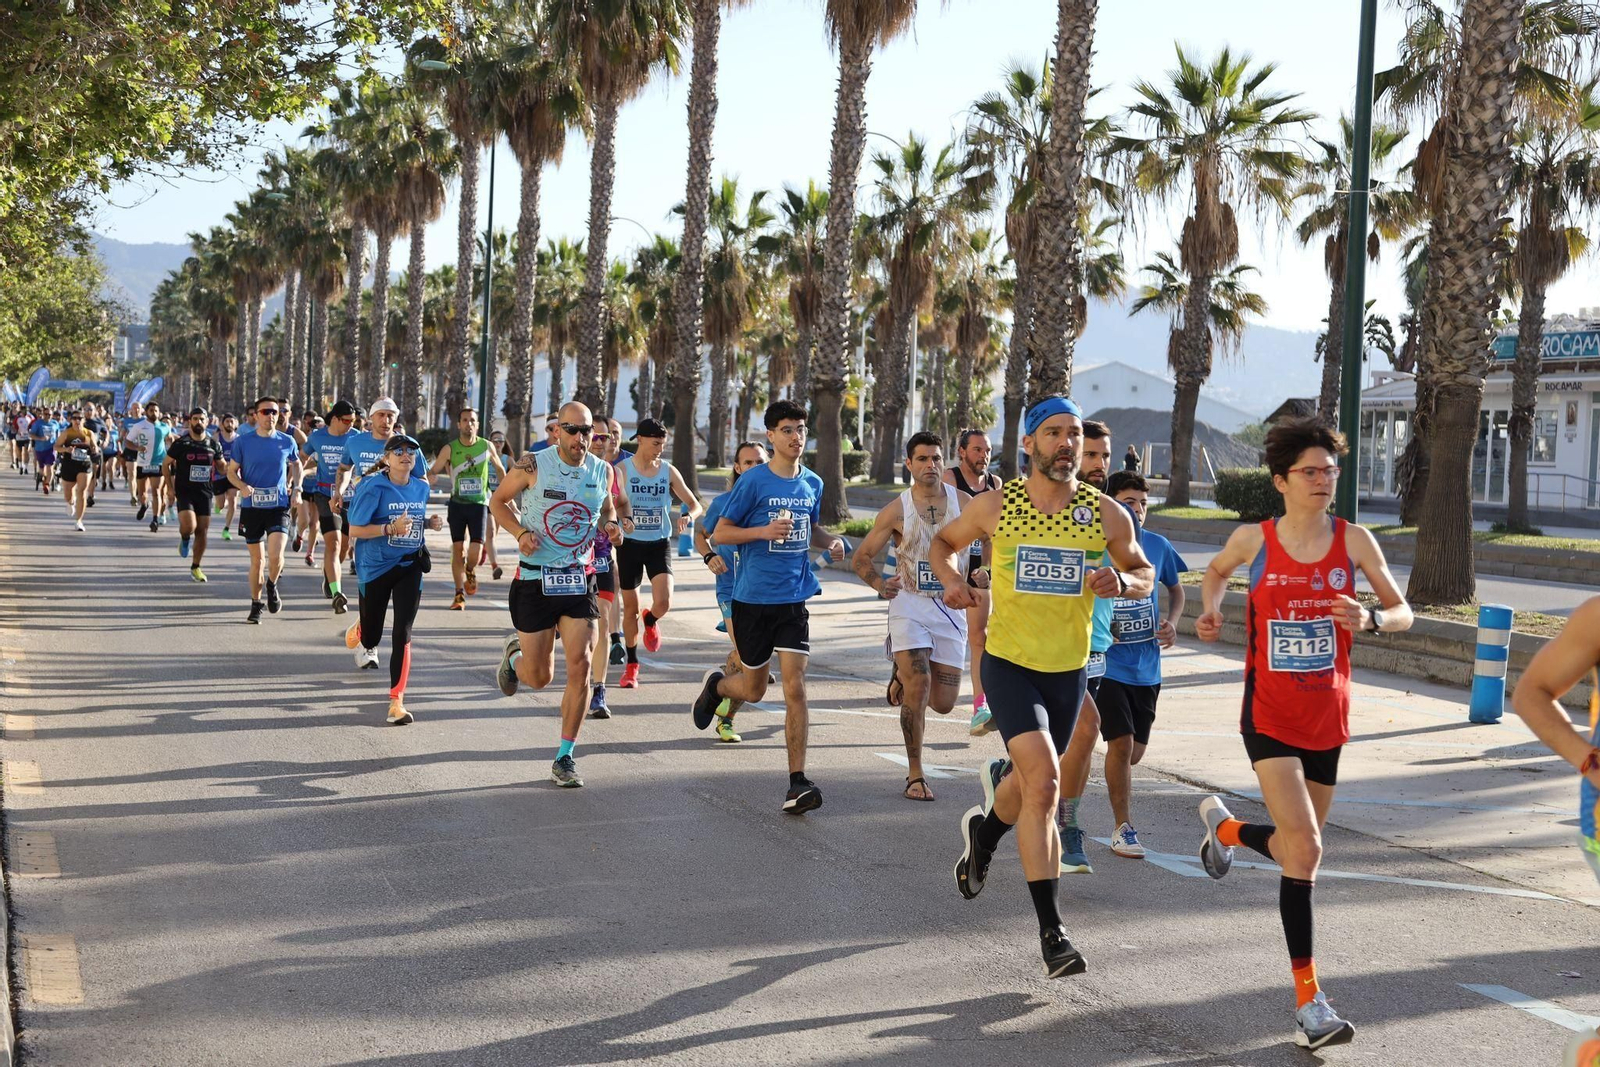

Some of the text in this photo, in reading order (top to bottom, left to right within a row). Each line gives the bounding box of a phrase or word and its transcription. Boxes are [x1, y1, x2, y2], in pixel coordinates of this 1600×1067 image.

[1545, 381, 1582, 391] ROCAMAR
[631, 483, 666, 496] nerja
[388, 501, 424, 510] mayoral
[636, 516, 660, 524] 1696
[1024, 563, 1076, 580] 2053
[548, 574, 581, 585] 1669
[1113, 597, 1153, 608] FRIENDS
[1287, 598, 1333, 609] ATLETISMO
[1278, 638, 1330, 655] 2112
